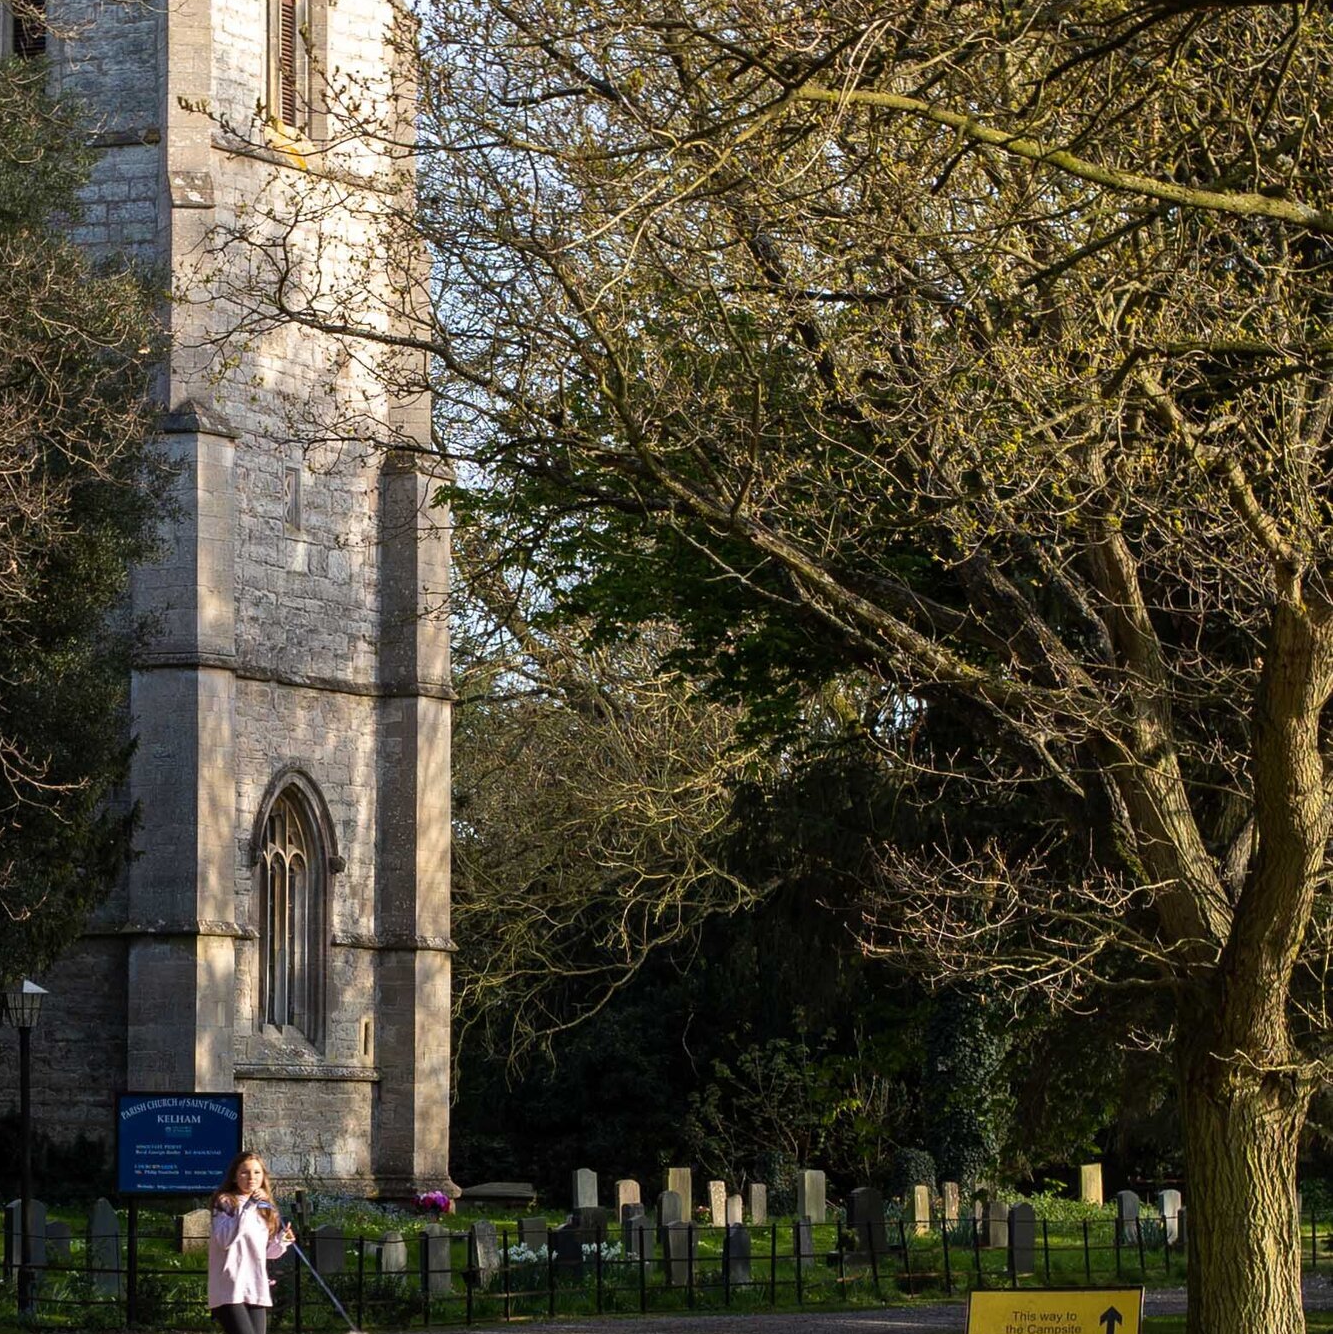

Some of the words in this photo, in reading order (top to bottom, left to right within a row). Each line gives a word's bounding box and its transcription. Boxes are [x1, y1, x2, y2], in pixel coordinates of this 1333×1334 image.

[120, 1102, 147, 1120] PARISH
[147, 1098, 178, 1110] CHURCH
[178, 1098, 186, 1109] of
[186, 1098, 209, 1110] SAINT
[209, 1102, 239, 1121] WILFRID
[157, 1114, 201, 1124] KELHAM
[1012, 1311, 1037, 1322] This
[1039, 1313, 1062, 1324] way
[1066, 1311, 1077, 1322] to
[1005, 1324, 1024, 1334] the
